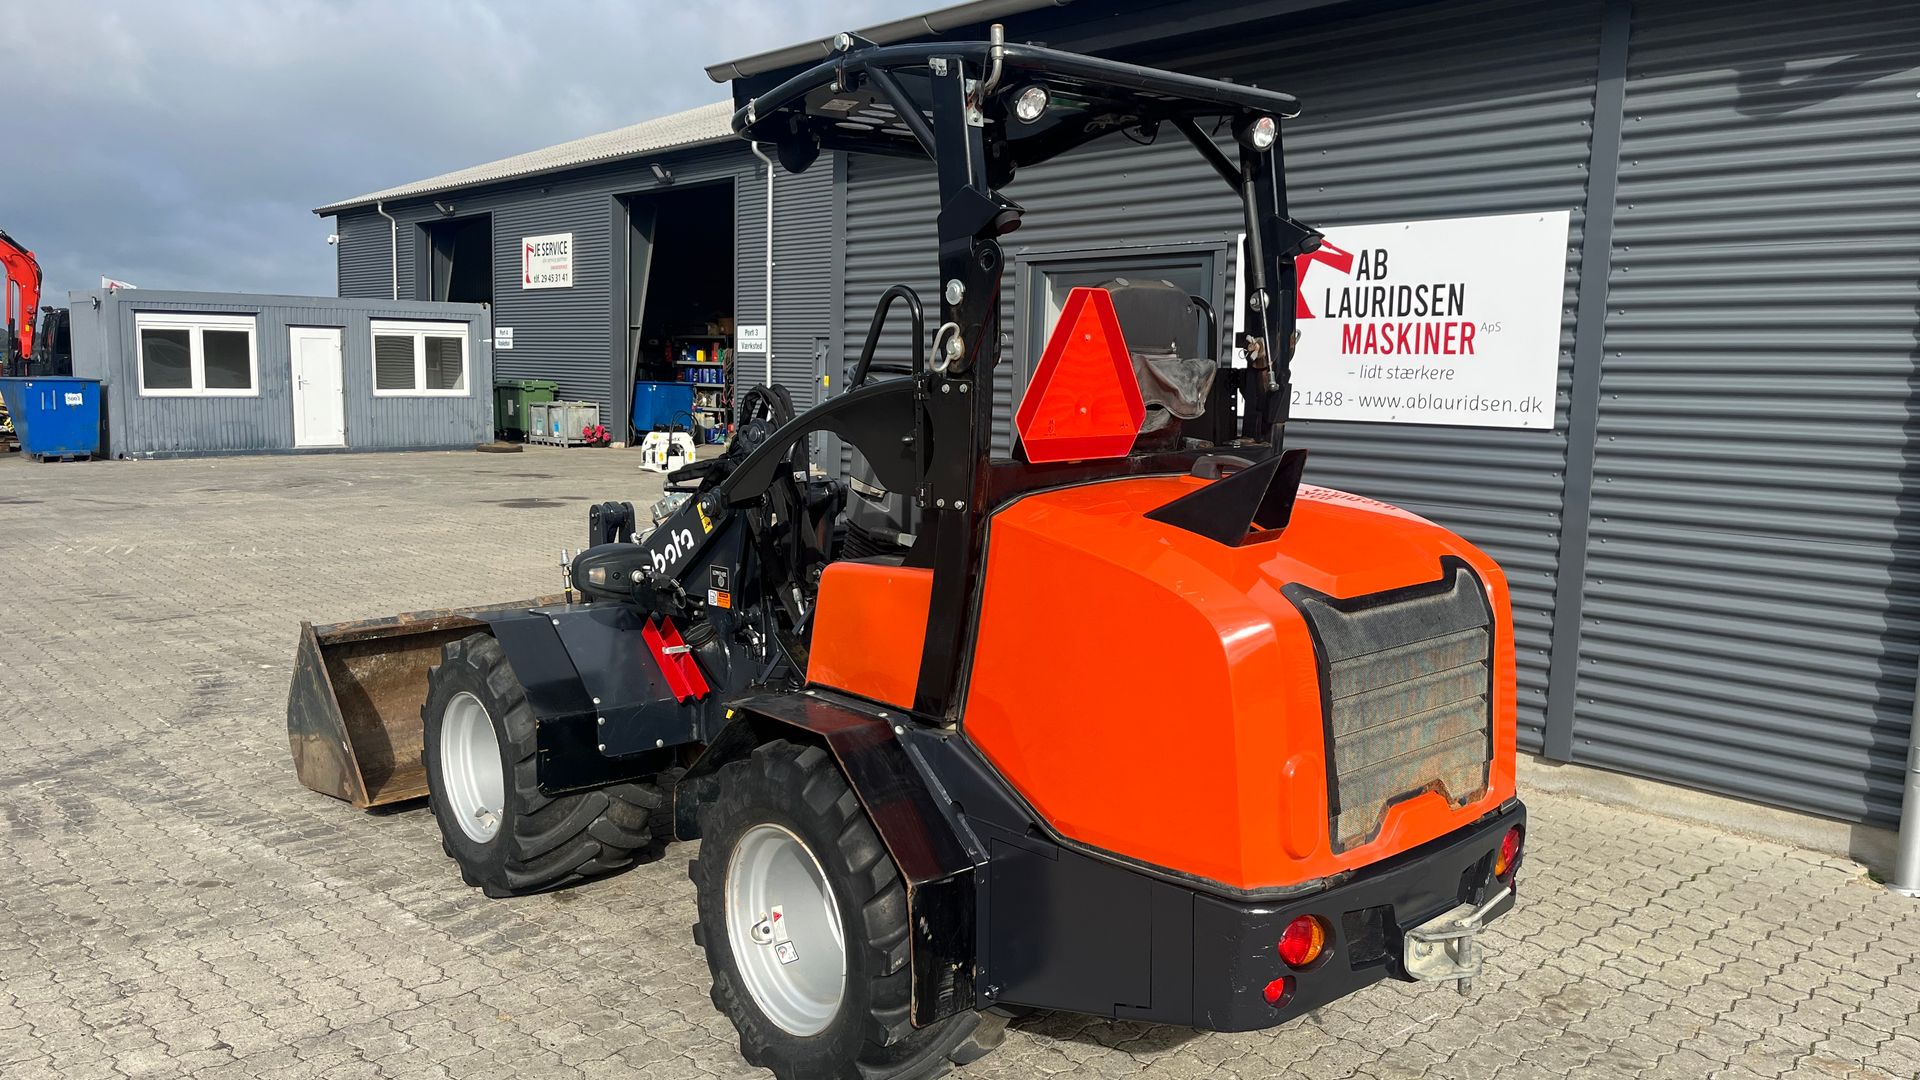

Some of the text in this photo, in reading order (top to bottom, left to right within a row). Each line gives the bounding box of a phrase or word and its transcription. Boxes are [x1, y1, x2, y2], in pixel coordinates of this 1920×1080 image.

[533, 240, 567, 257] JE SERVICE
[1356, 248, 1388, 281] AB
[541, 273, 548, 283] 29
[548, 273, 555, 283] 45
[555, 273, 561, 283] 31
[562, 272, 568, 282] 41
[1325, 283, 1465, 318] LAURIDSEN
[1341, 321, 1477, 355] MASKINER
[1480, 322, 1503, 335] ApS
[1359, 365, 1383, 379] lidt
[1386, 365, 1455, 381] stærkere
[1305, 391, 1344, 407] 1488
[1358, 393, 1543, 413] www.ablauridsen.dk
